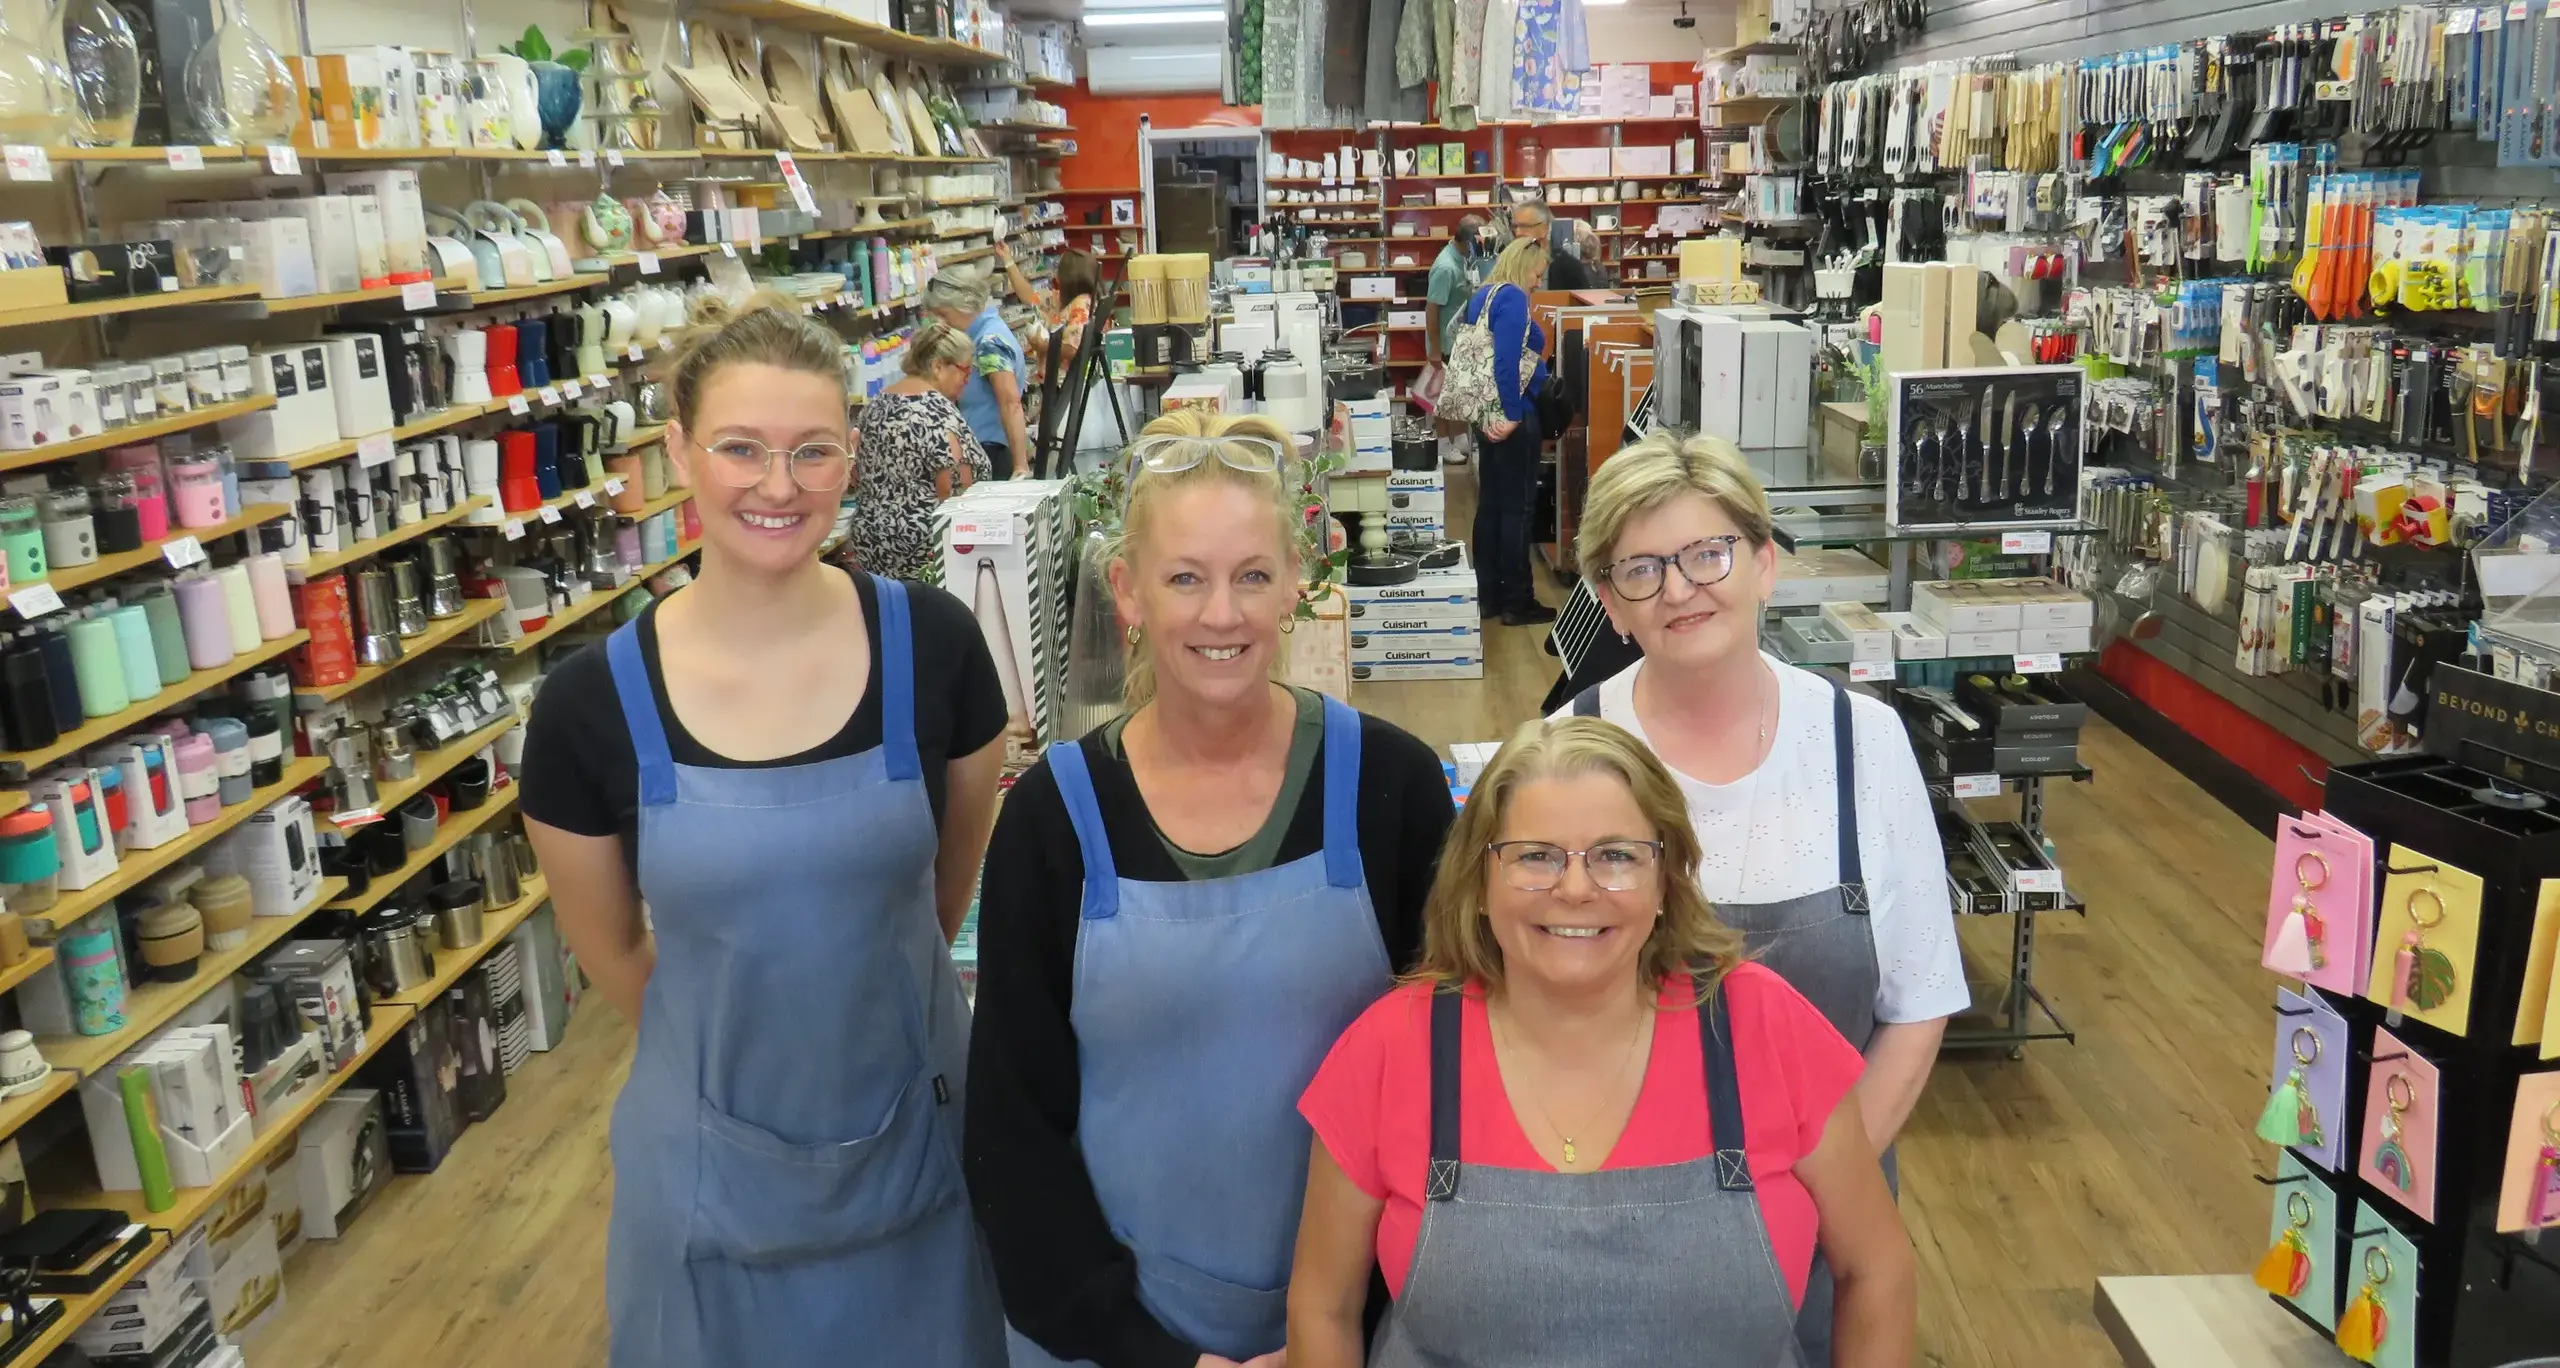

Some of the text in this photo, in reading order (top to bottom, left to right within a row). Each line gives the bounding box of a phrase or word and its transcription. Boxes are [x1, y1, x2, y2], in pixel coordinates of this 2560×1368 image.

[1908, 383, 1924, 395] 56
[1925, 382, 1963, 390] Manchester
[1390, 477, 1434, 486] Cuisinart
[2024, 507, 2048, 517] Stanley
[2049, 507, 2071, 518] Rogers
[1390, 515, 1434, 524] Cuisinart
[1379, 589, 1425, 598] Cuisinart
[1382, 620, 1428, 629] Cuisinart
[1385, 651, 1431, 660] Cuisinart
[2438, 692, 2508, 722] BEYOND
